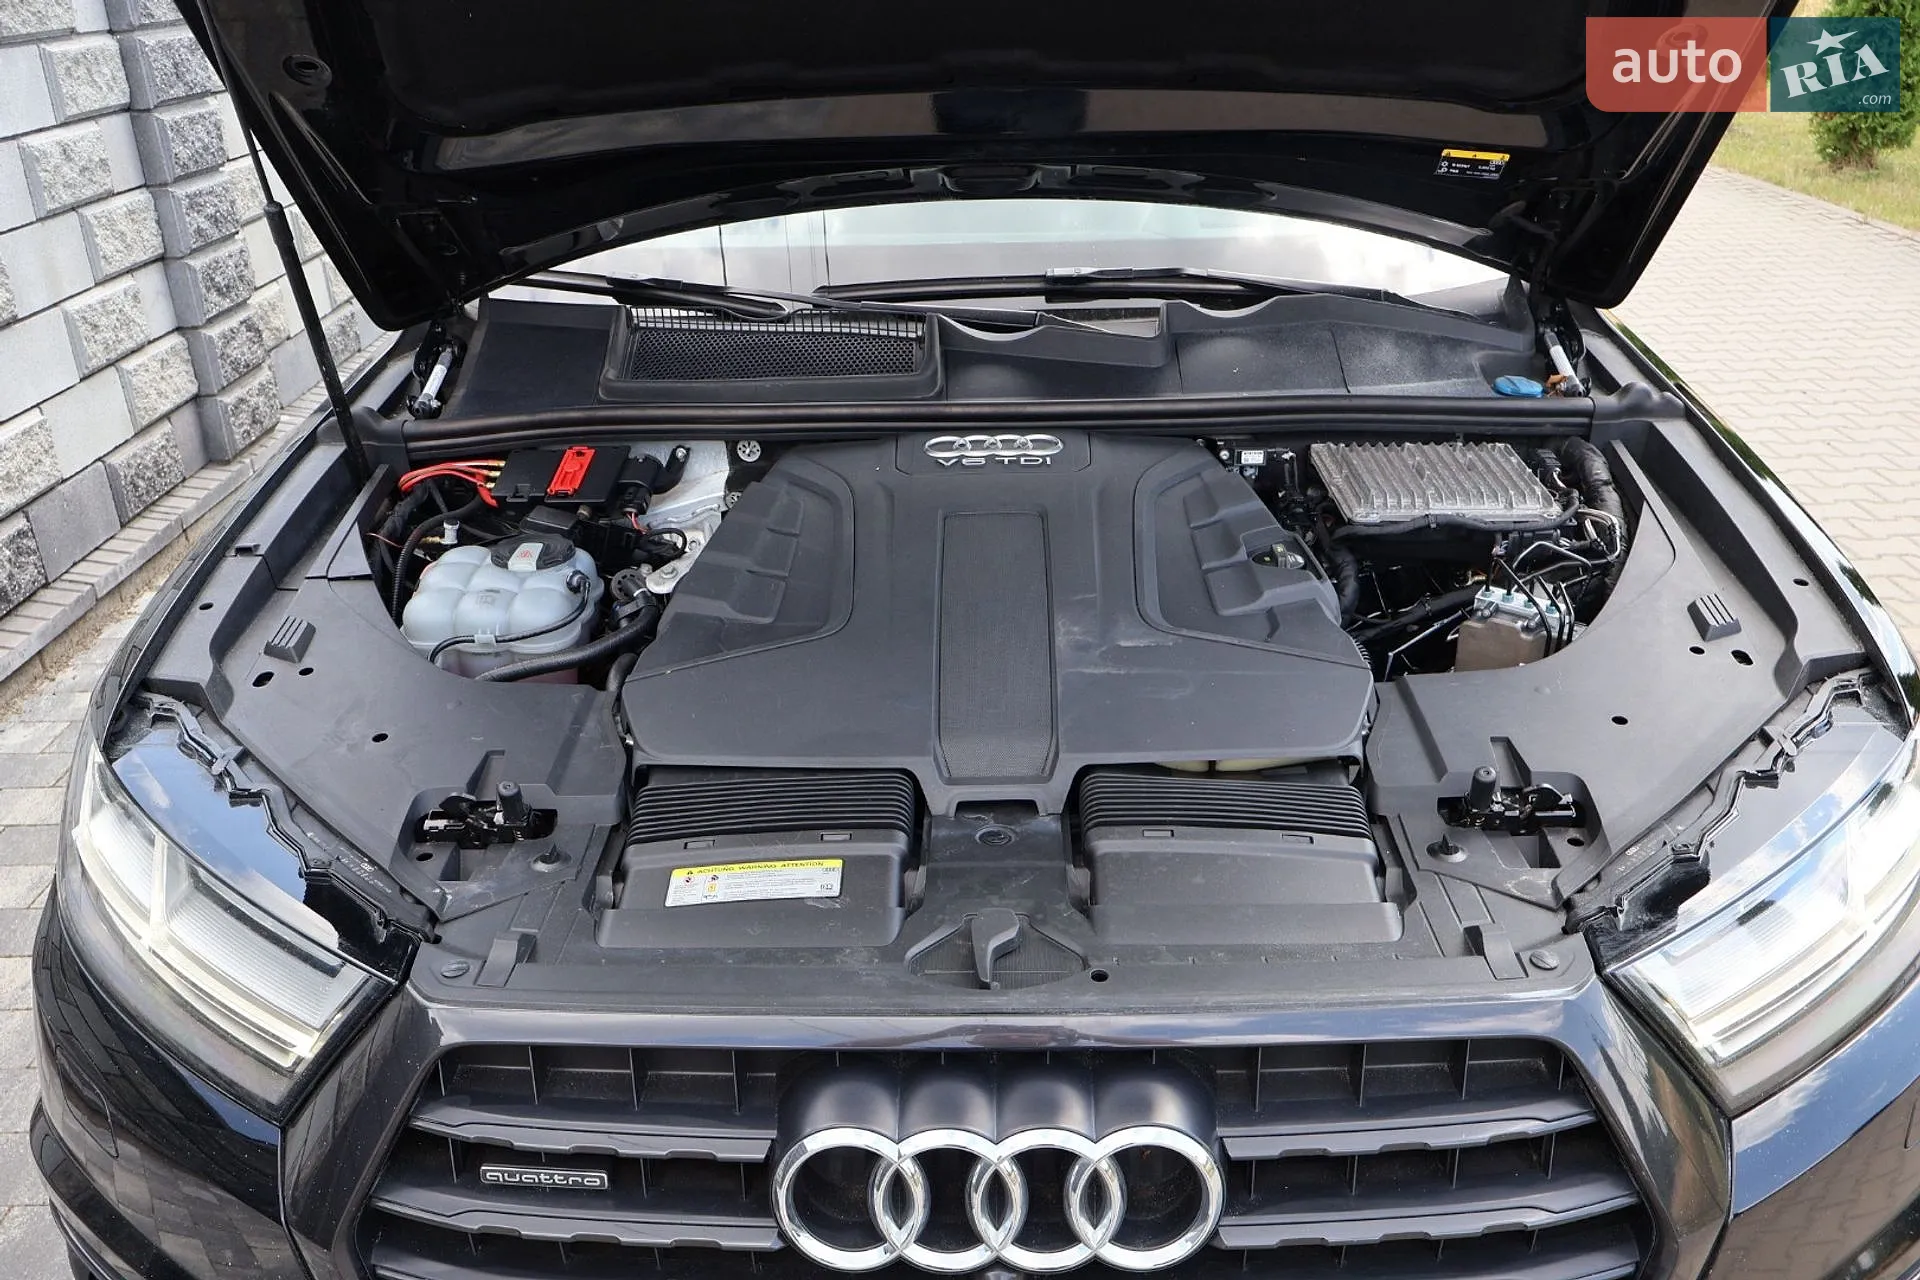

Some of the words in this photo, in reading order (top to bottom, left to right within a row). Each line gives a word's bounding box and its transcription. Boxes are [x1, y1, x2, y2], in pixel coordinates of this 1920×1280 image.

[936, 457, 986, 466] V6
[995, 456, 1051, 465] TDI
[696, 866, 735, 874] ACHTUNG
[738, 863, 777, 871] WARNING
[486, 1172, 601, 1185] quattro
